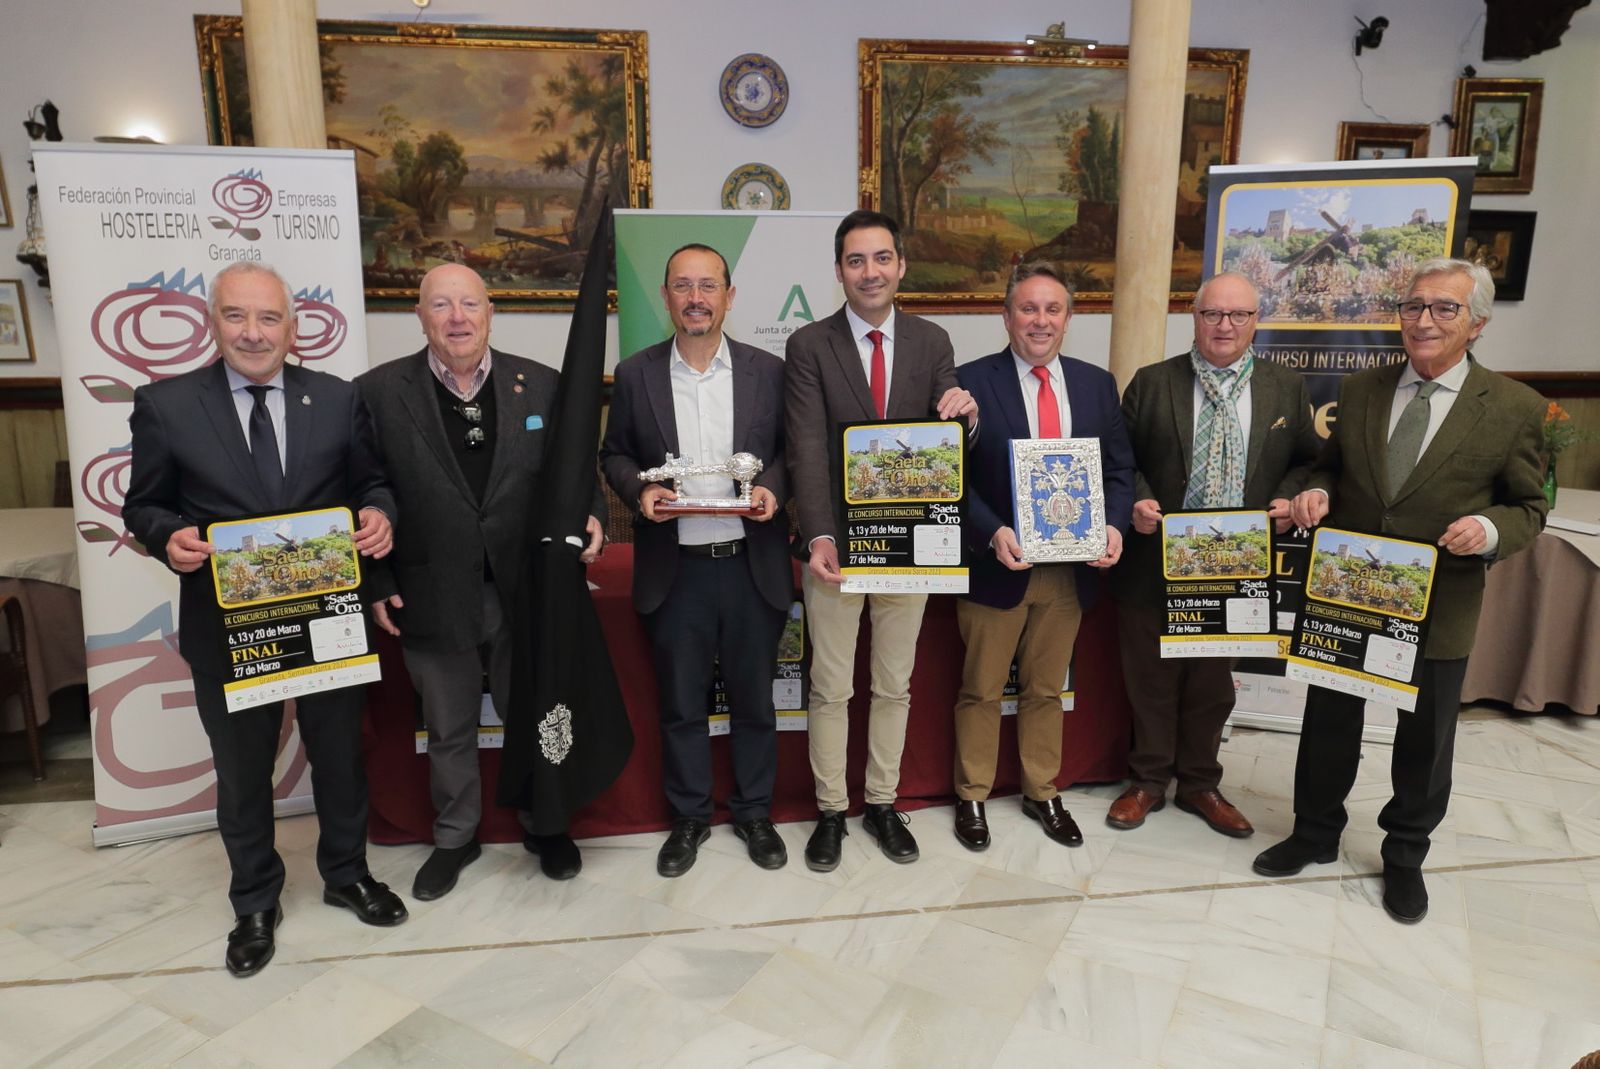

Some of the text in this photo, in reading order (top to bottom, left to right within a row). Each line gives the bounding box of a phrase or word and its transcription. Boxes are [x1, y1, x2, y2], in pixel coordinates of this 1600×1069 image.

[58, 186, 196, 206] Federación Provincial
[278, 190, 337, 211] Empresas
[100, 212, 202, 239] HOSTELERIA
[272, 214, 340, 240] TURISMO
[208, 243, 262, 262] Granada
[753, 325, 780, 334] Junta
[780, 325, 793, 334] de
[1257, 350, 1308, 369] CURSO
[884, 454, 927, 470] Saeta
[847, 508, 925, 518] IX CONCURSO INTERNACIONAL
[933, 503, 959, 514] Saeta
[937, 513, 961, 525] Oro
[848, 525, 907, 536] 6, 13 y 20 de Marzo
[849, 540, 890, 552] FINAL
[1198, 537, 1237, 551] Saeta
[262, 545, 315, 566] Saeta
[849, 555, 887, 564] 27 de Marzo
[272, 565, 322, 584] Oro
[1350, 562, 1393, 583] Saeta
[1172, 585, 1199, 593] CONCURSO
[1199, 584, 1236, 592] INTERNACIONAL
[1244, 580, 1268, 589] Saeta
[329, 592, 359, 605] Saeta
[1247, 588, 1269, 598] Oro
[325, 602, 363, 615] de Oro
[1167, 599, 1220, 608] 6, 13 y 20 de Marzo
[224, 602, 320, 625] IX CONCURSO INTERNACIONAL
[1168, 611, 1205, 622] FINAL
[1311, 605, 1340, 619] CONCURSO
[1341, 611, 1383, 628] INTERNACIONAL
[1168, 625, 1202, 633] 27 de Marzo
[1303, 619, 1362, 639] 6, 13 y 20 de Marzo
[1392, 618, 1419, 633] Saeta
[228, 624, 301, 645] 6, 13 y 20 de Marzo
[1301, 632, 1342, 651] FINAL
[1394, 629, 1419, 644] Oro
[231, 642, 284, 664] FINAL
[1298, 646, 1307, 656] 27
[1307, 648, 1316, 658] de
[1316, 649, 1336, 662] Marzo
[234, 661, 281, 678] 27 de Marzo
[781, 662, 801, 671] Saeta
[783, 670, 802, 679] Oro
